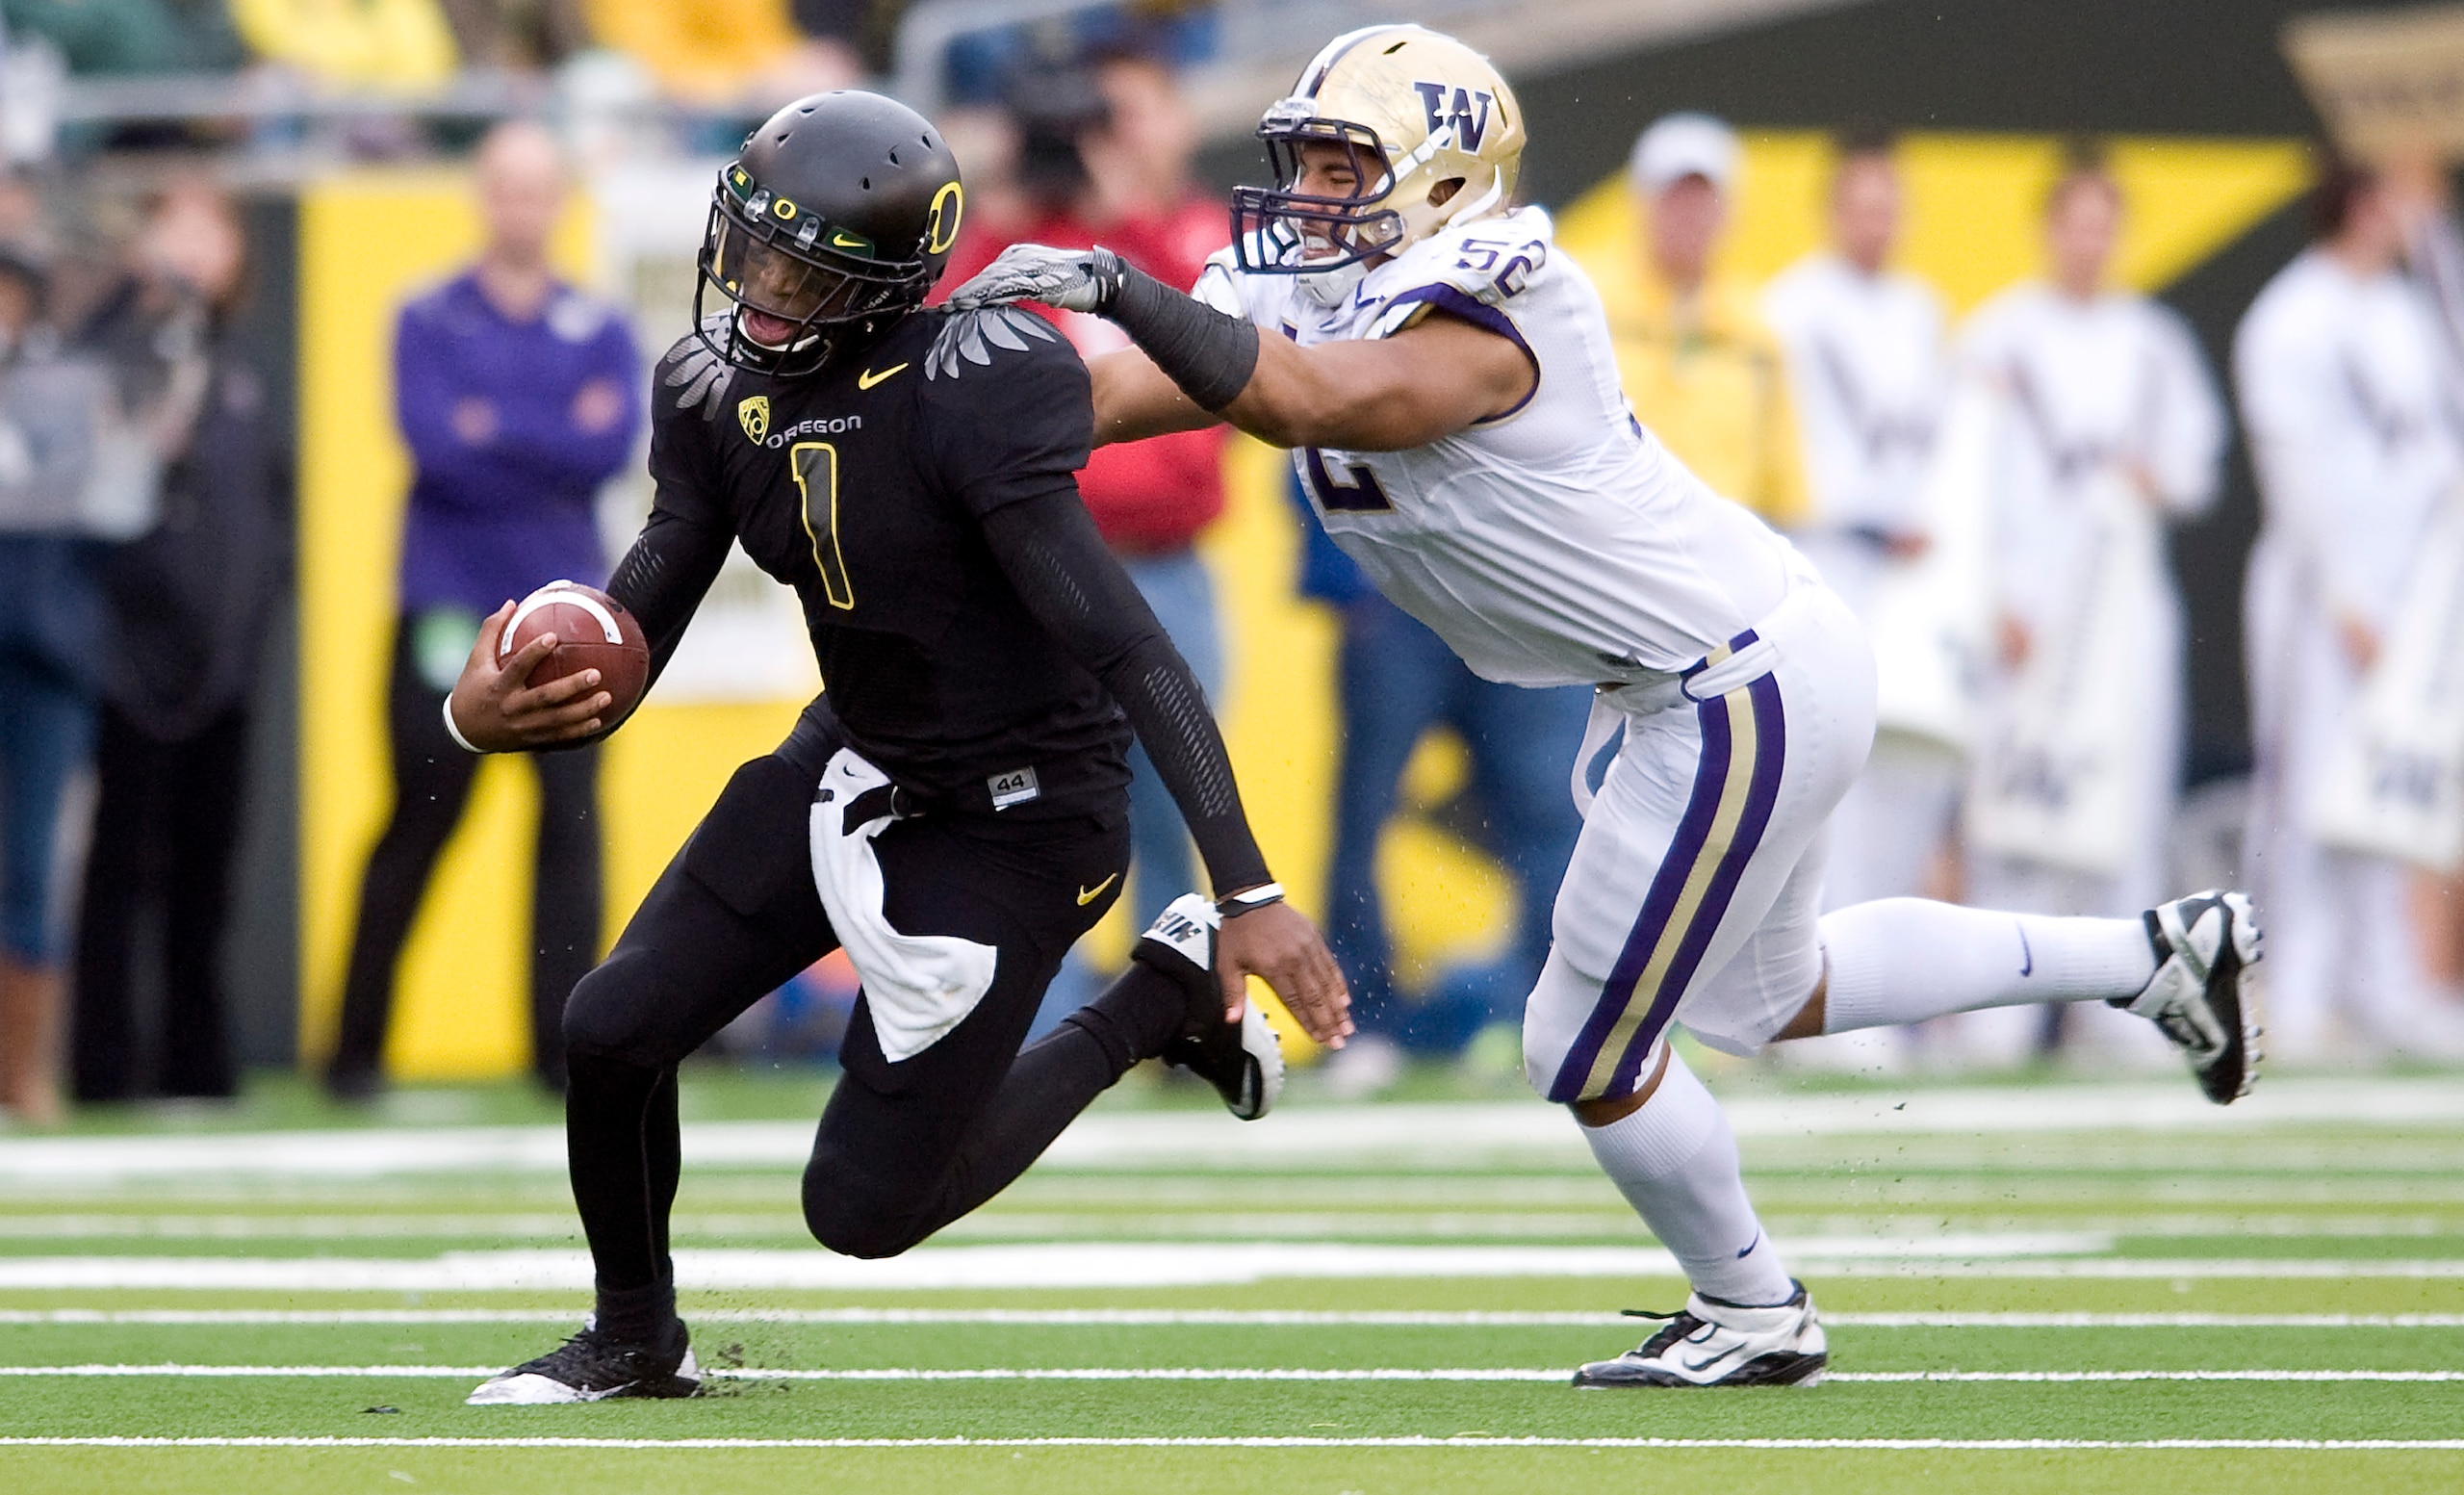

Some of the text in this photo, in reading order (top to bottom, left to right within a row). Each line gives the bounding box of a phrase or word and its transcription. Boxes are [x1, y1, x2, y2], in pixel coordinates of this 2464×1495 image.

[1412, 81, 1494, 155] W
[772, 197, 797, 220] O
[928, 181, 962, 255] O
[1454, 238, 1548, 298] 52
[766, 415, 862, 450] OREGON
[790, 441, 855, 610] 1
[997, 774, 1024, 790] 44
